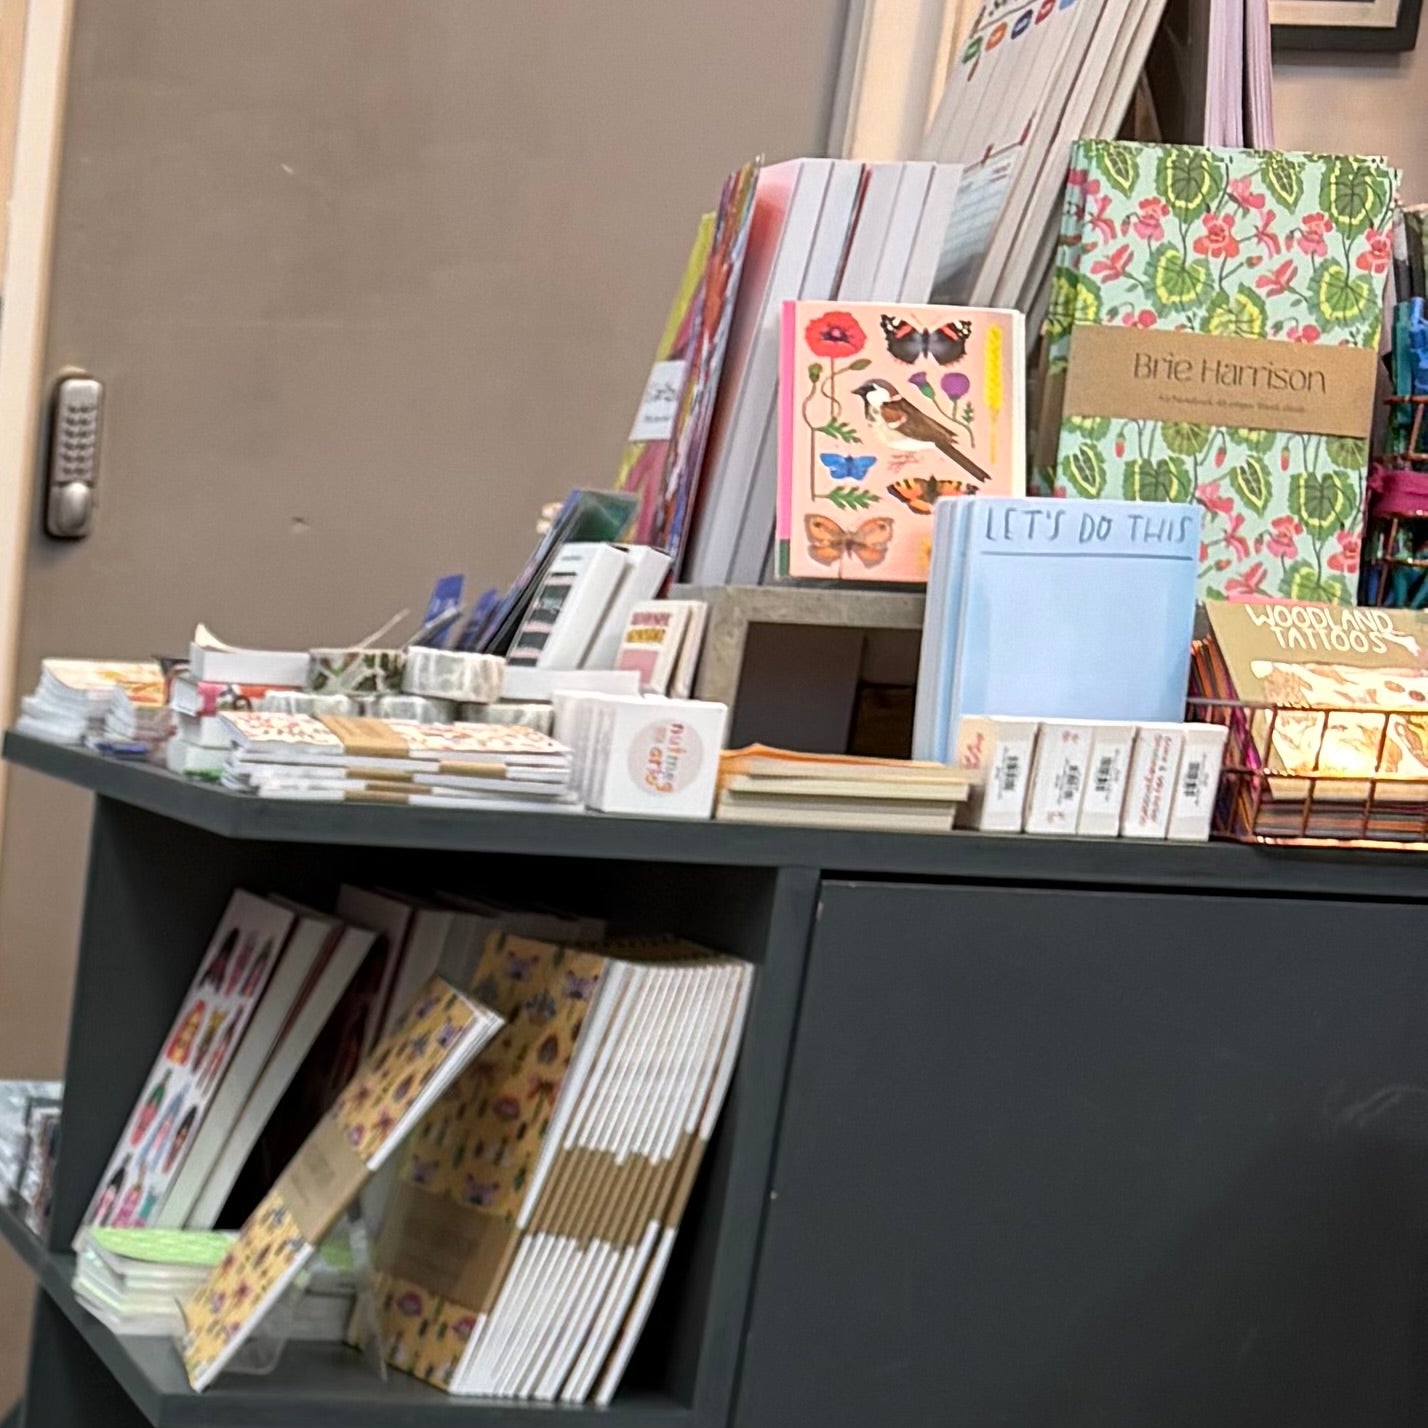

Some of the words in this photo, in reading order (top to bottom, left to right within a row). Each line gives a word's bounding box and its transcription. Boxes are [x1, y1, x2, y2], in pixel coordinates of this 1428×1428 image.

[1134, 352, 1192, 381] Brie
[1201, 358, 1326, 393] Harrison
[985, 507, 1066, 541] LET'S
[1079, 514, 1111, 541] DO
[1128, 514, 1192, 543] THIS
[1244, 603, 1393, 633] WOODLAND
[1270, 626, 1387, 654] TATTOOS
